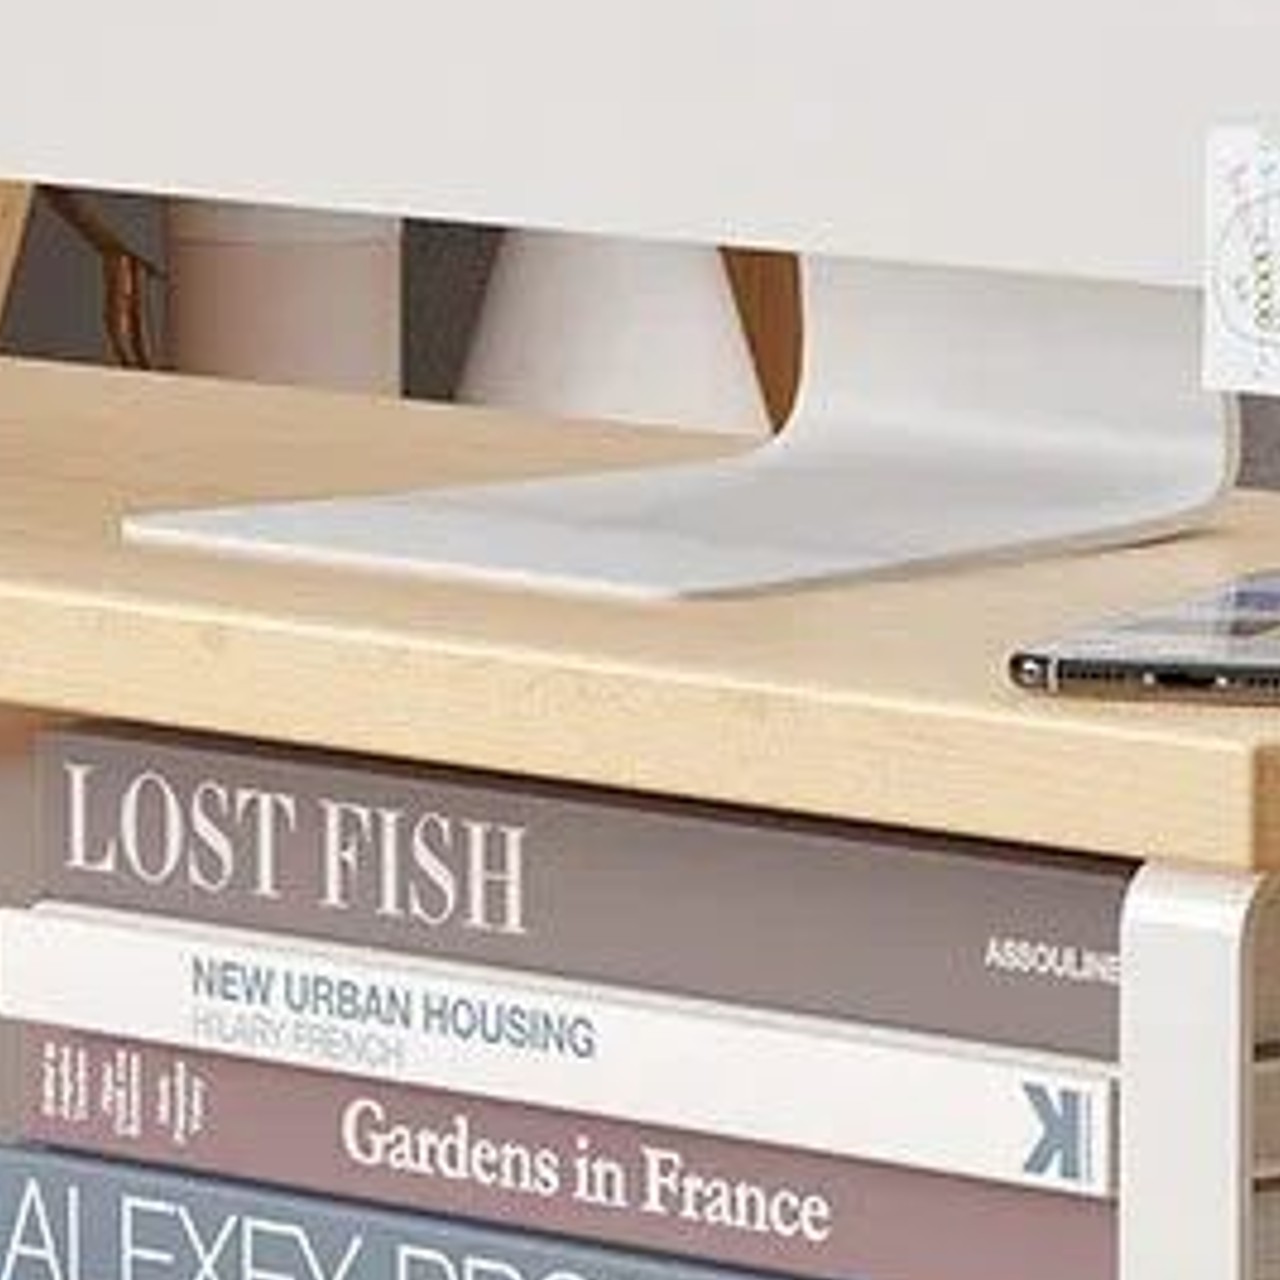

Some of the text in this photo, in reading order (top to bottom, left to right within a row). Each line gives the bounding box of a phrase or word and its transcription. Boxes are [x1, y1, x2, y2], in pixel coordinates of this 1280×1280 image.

[64, 762, 527, 935] LOST FISH
[191, 957, 597, 1060] NEW URBAN HOUSING
[341, 1096, 833, 1242] Gardens in France
